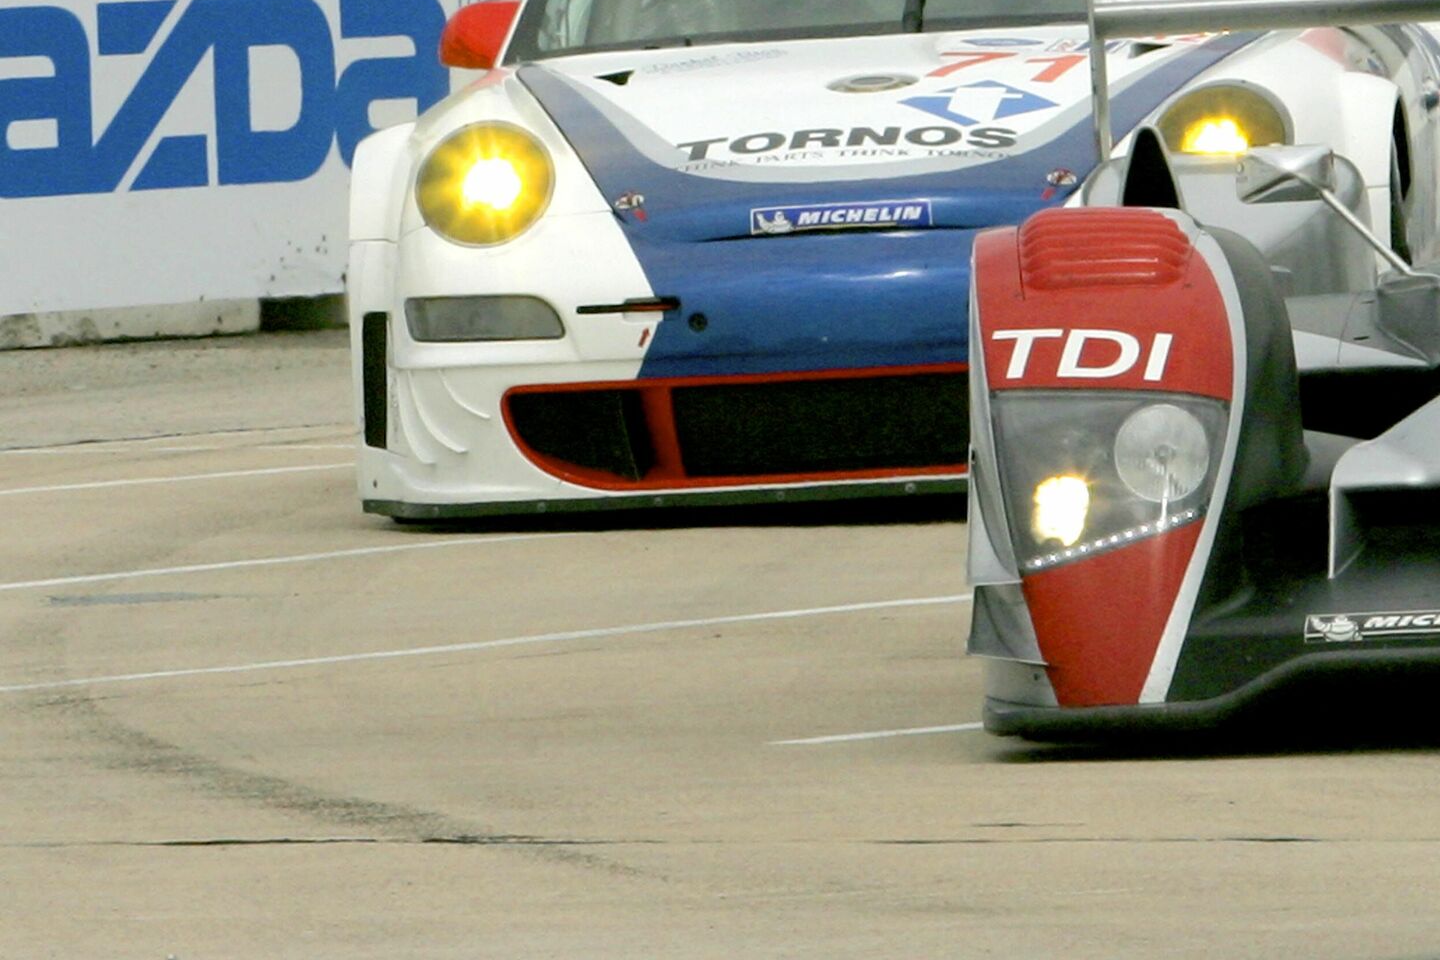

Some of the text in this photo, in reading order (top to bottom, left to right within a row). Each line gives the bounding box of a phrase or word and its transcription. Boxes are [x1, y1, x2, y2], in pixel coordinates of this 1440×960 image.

[925, 51, 1088, 82] 71
[676, 126, 1018, 161] TORNOS
[839, 149, 908, 157] THINK
[797, 206, 922, 225] MICHELIN
[992, 328, 1173, 381] TDI
